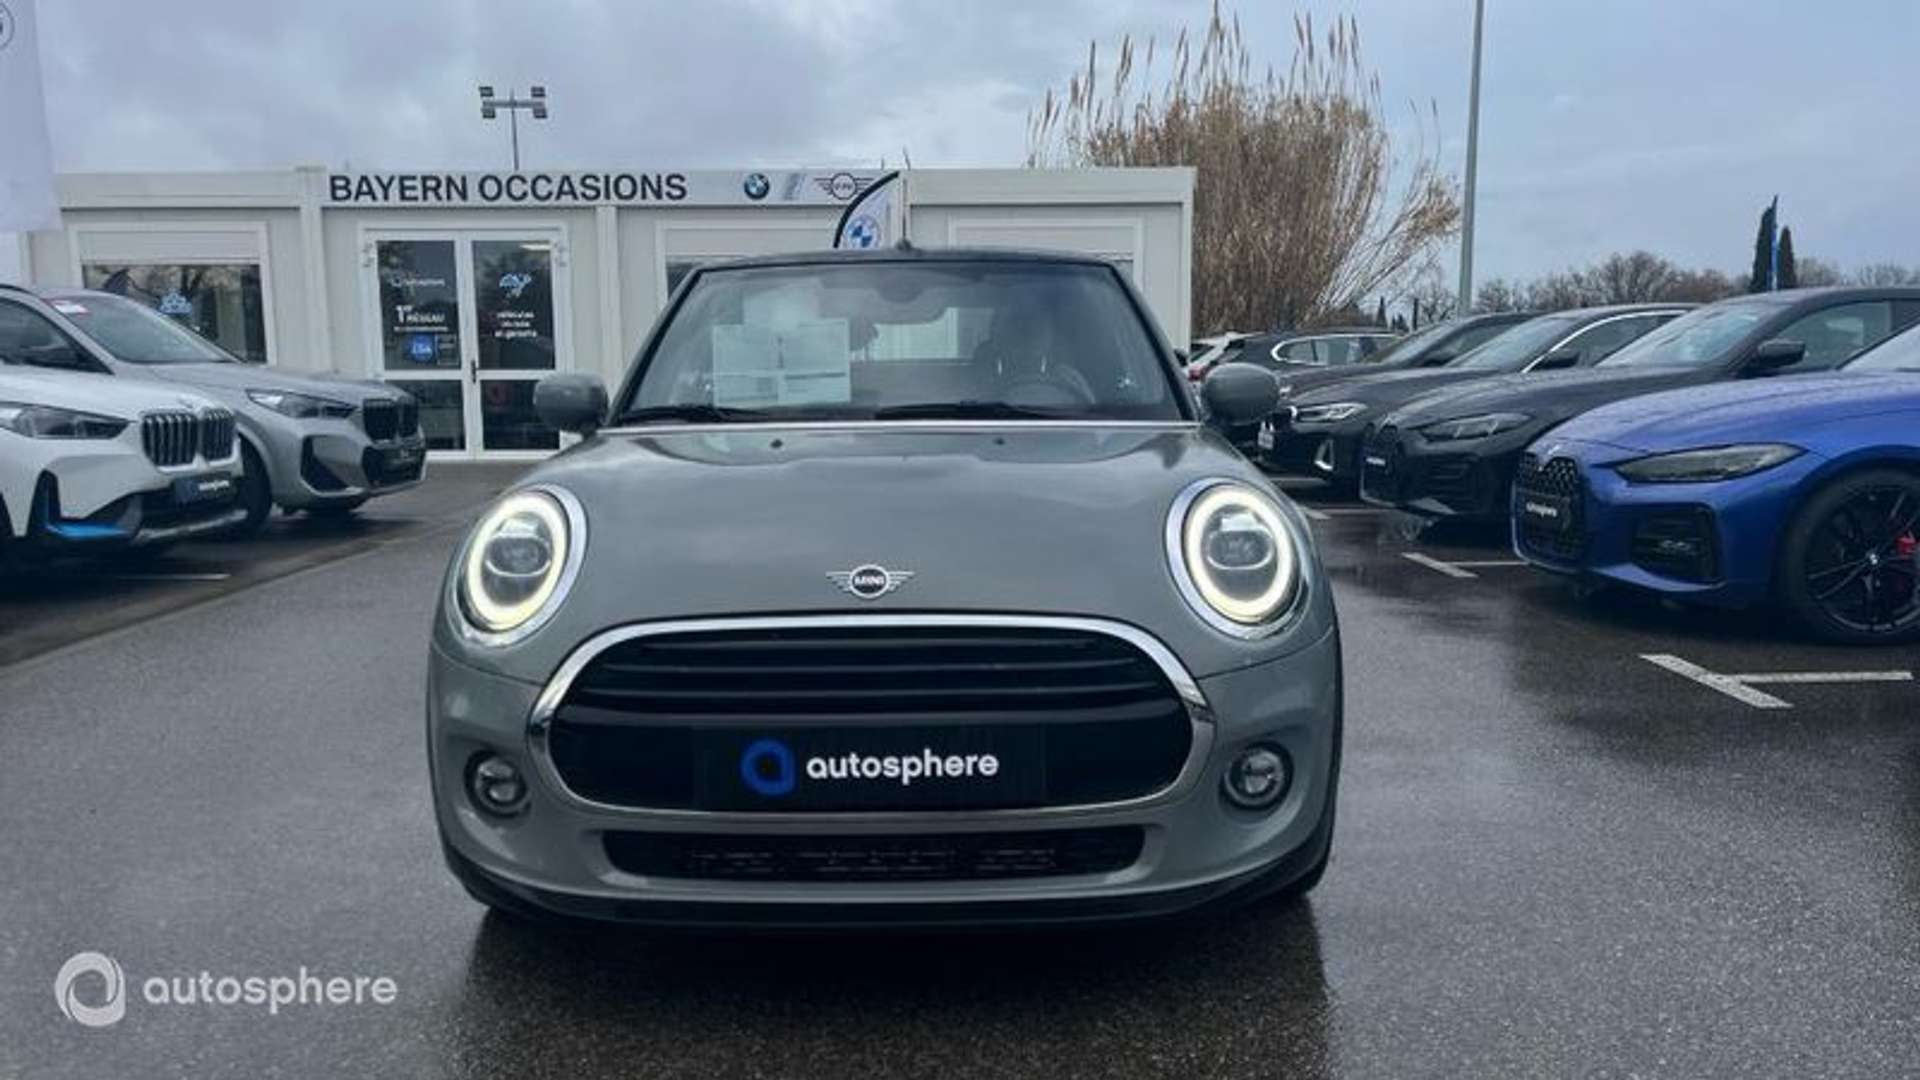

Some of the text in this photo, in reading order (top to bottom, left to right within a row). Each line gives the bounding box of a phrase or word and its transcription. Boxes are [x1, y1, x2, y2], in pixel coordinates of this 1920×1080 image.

[329, 173, 687, 201] BAYERN OCCASIONS
[806, 748, 999, 786] autosphere
